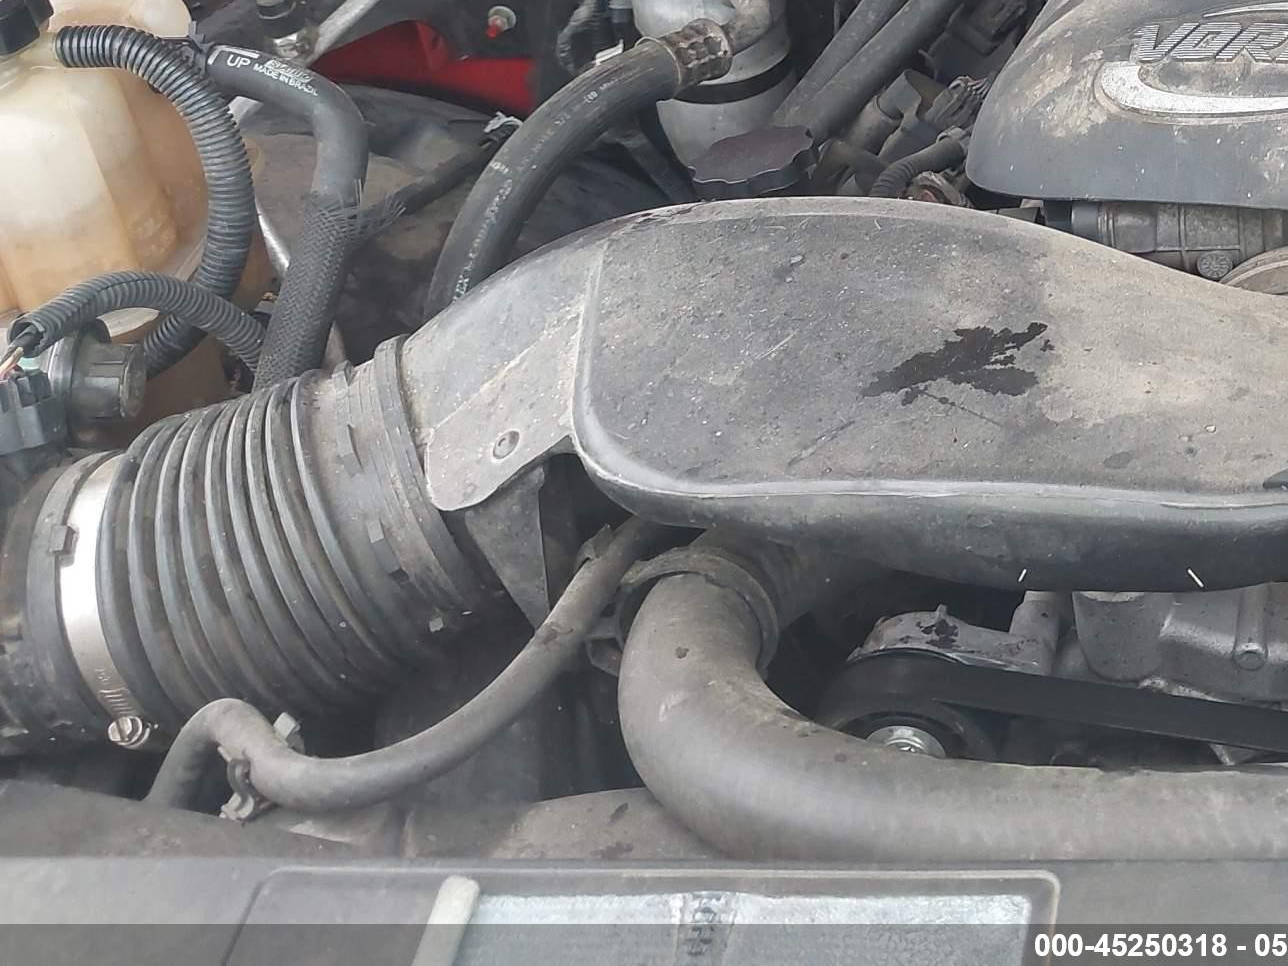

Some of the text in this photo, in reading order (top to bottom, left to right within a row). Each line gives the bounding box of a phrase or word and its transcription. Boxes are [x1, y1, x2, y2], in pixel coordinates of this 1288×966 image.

[226, 54, 251, 68] UP
[253, 63, 279, 80] MADE
[279, 74, 289, 84] IN
[289, 77, 319, 97] BRAZIL
